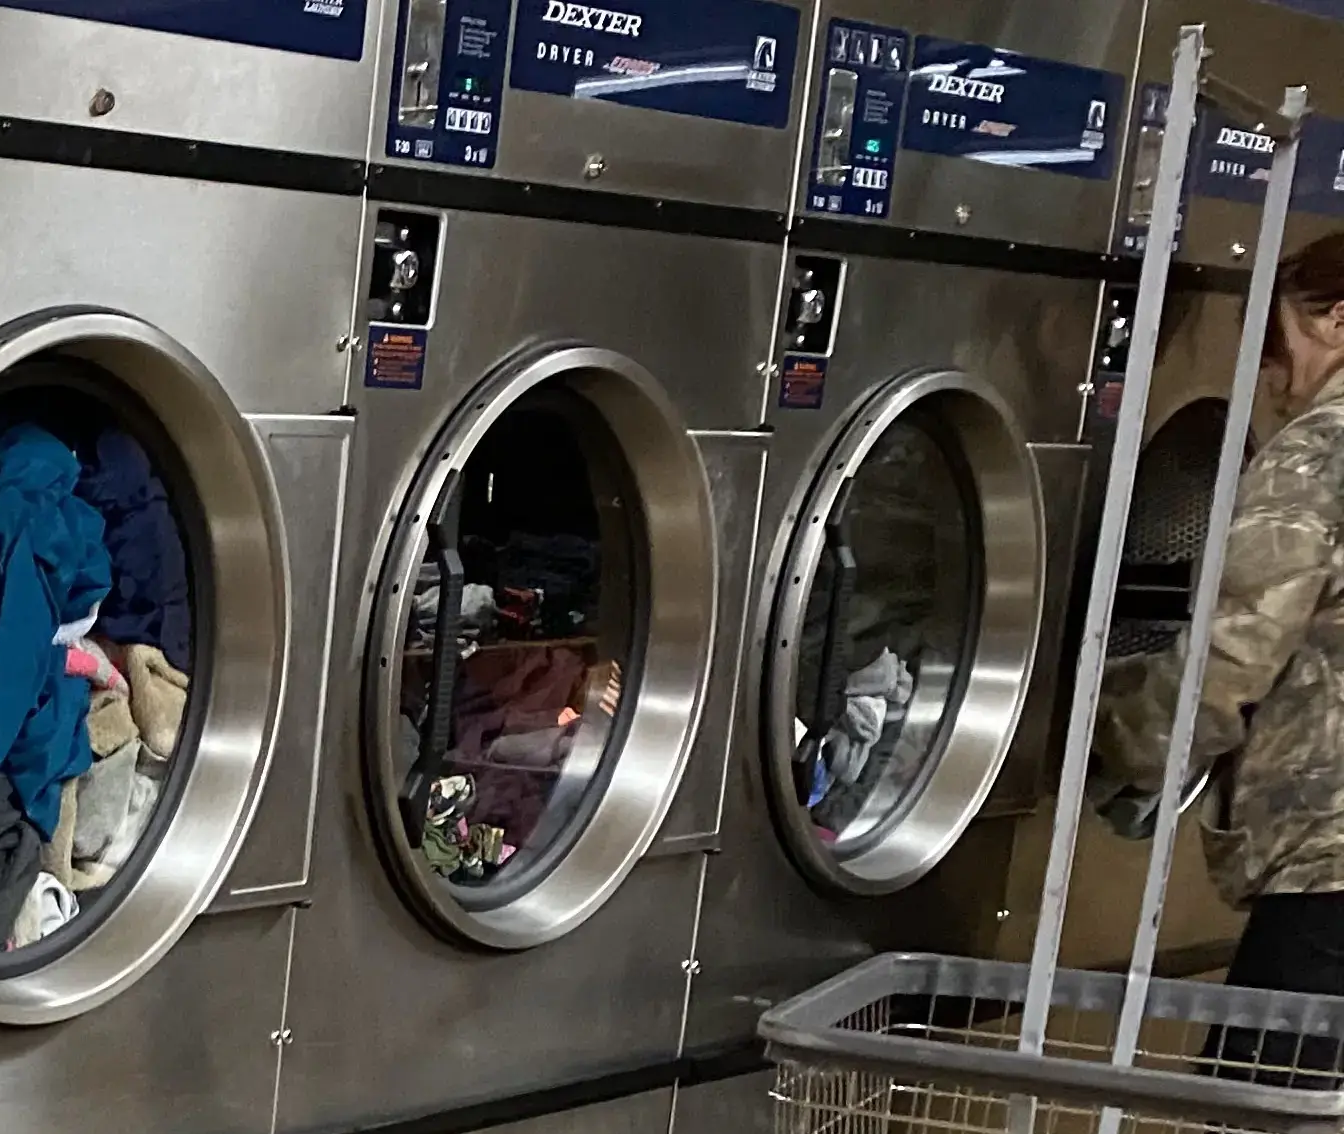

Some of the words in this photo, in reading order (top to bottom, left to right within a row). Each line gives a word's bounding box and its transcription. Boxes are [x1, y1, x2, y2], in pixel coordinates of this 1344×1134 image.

[542, 0, 643, 37] DEXTER
[536, 42, 595, 67] DRYER
[928, 74, 1005, 104] DEXTER
